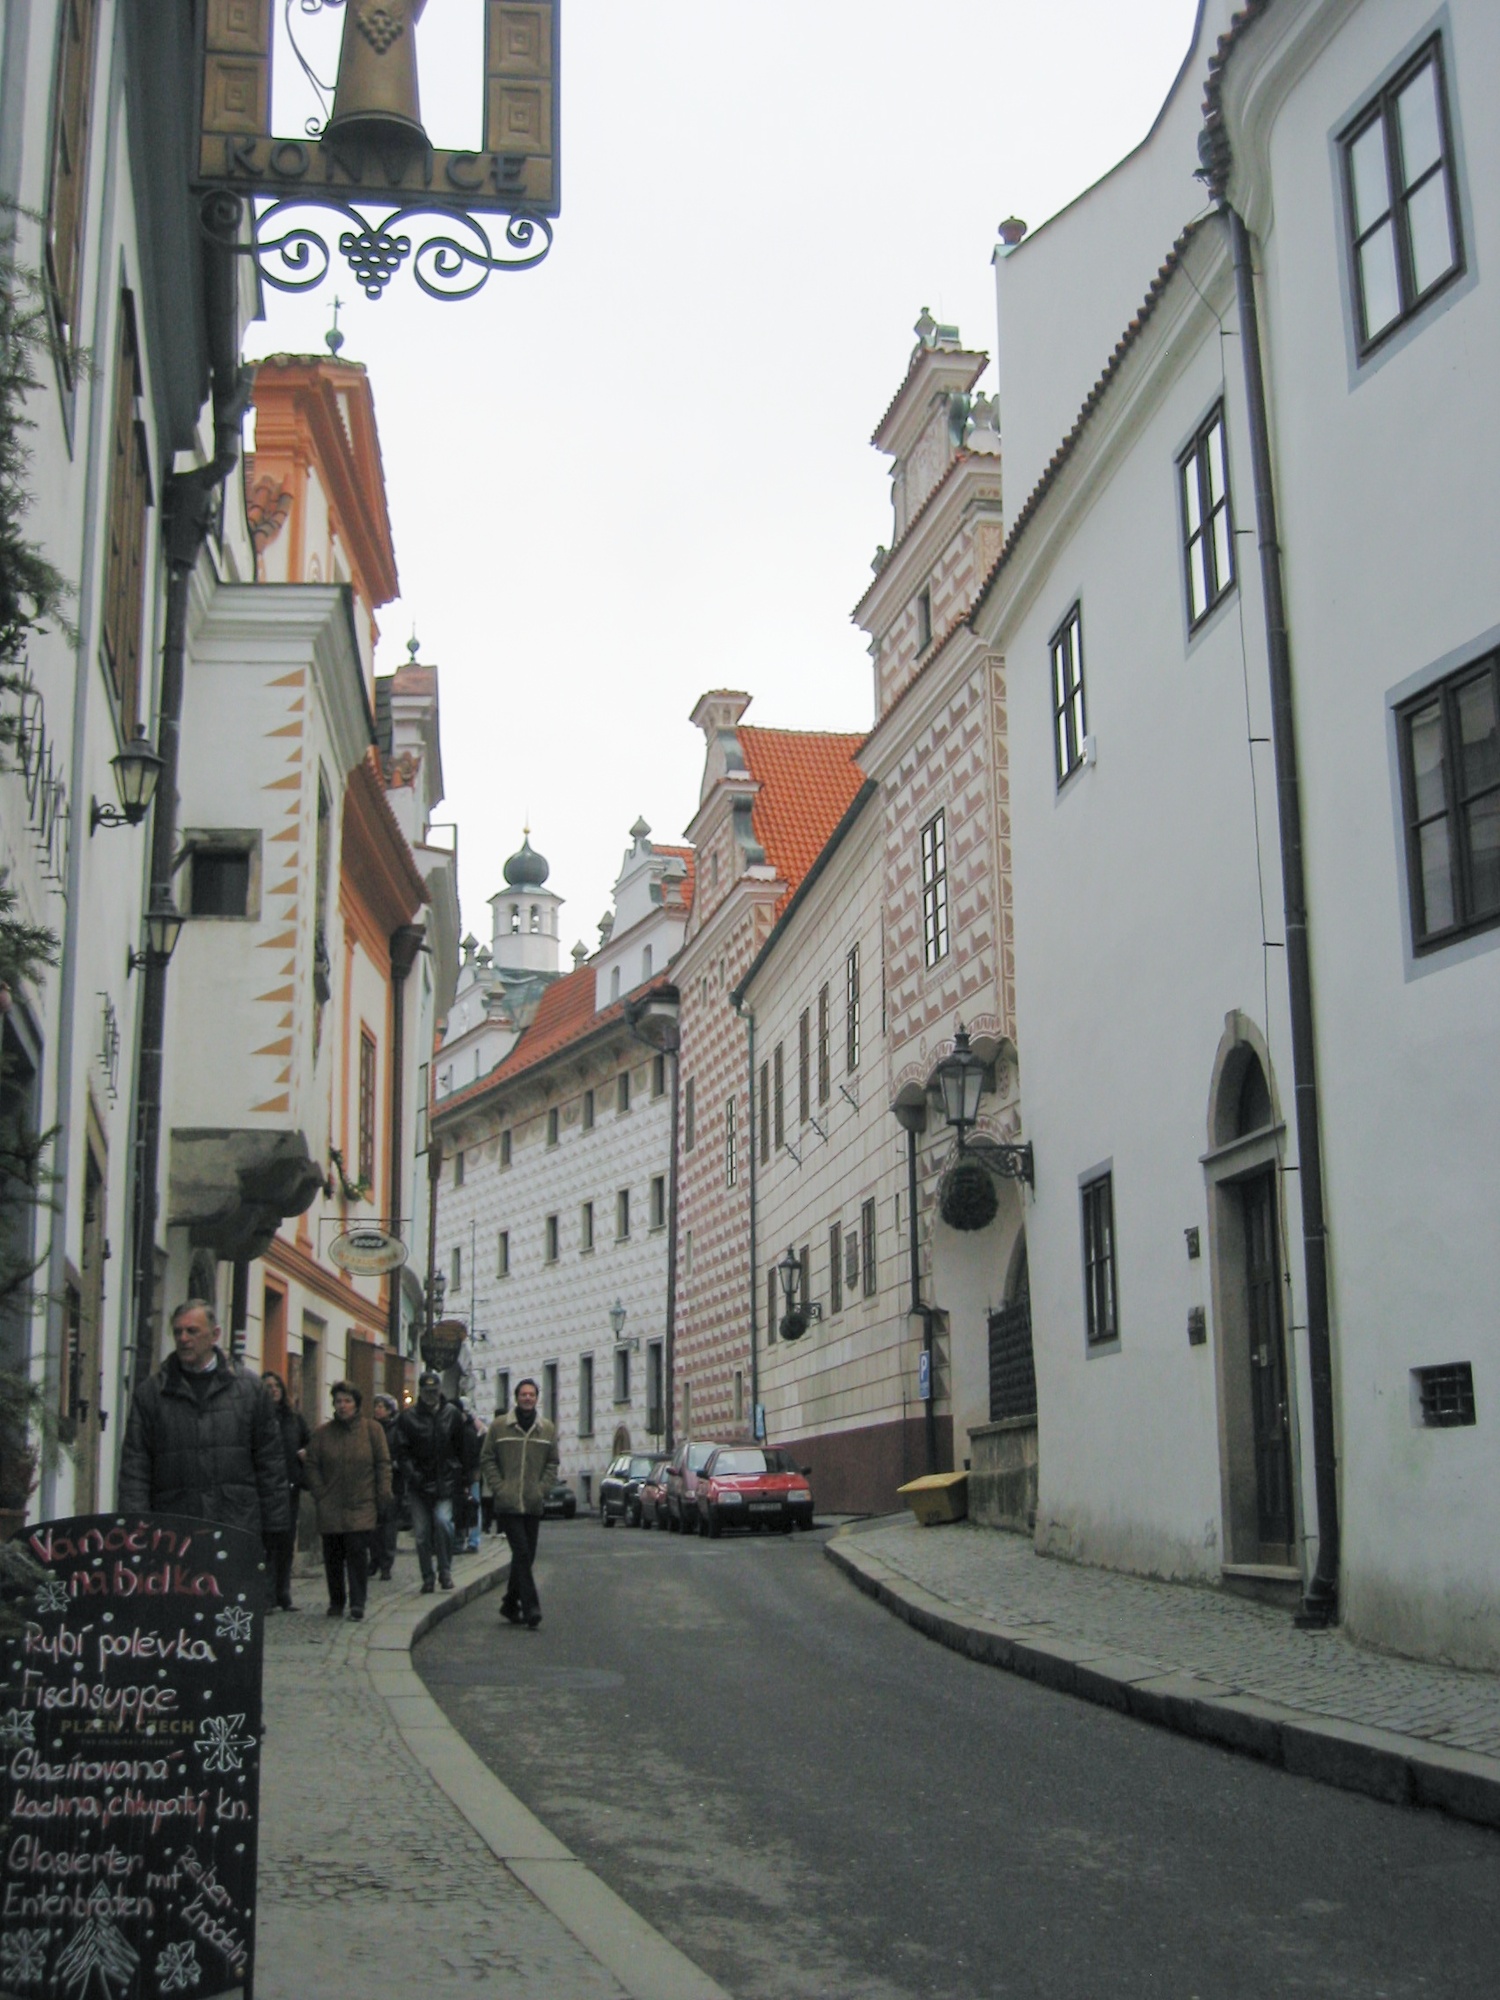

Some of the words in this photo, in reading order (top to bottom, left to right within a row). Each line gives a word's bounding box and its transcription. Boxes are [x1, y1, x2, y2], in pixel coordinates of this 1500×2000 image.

[225, 135, 528, 194] KONVICE
[921, 1355, 927, 1380] P
[25, 1621, 94, 1664] Rybí
[99, 1627, 217, 1672] polévka
[22, 1667, 180, 1729] Fischsuppe
[146, 1864, 183, 1891] mit
